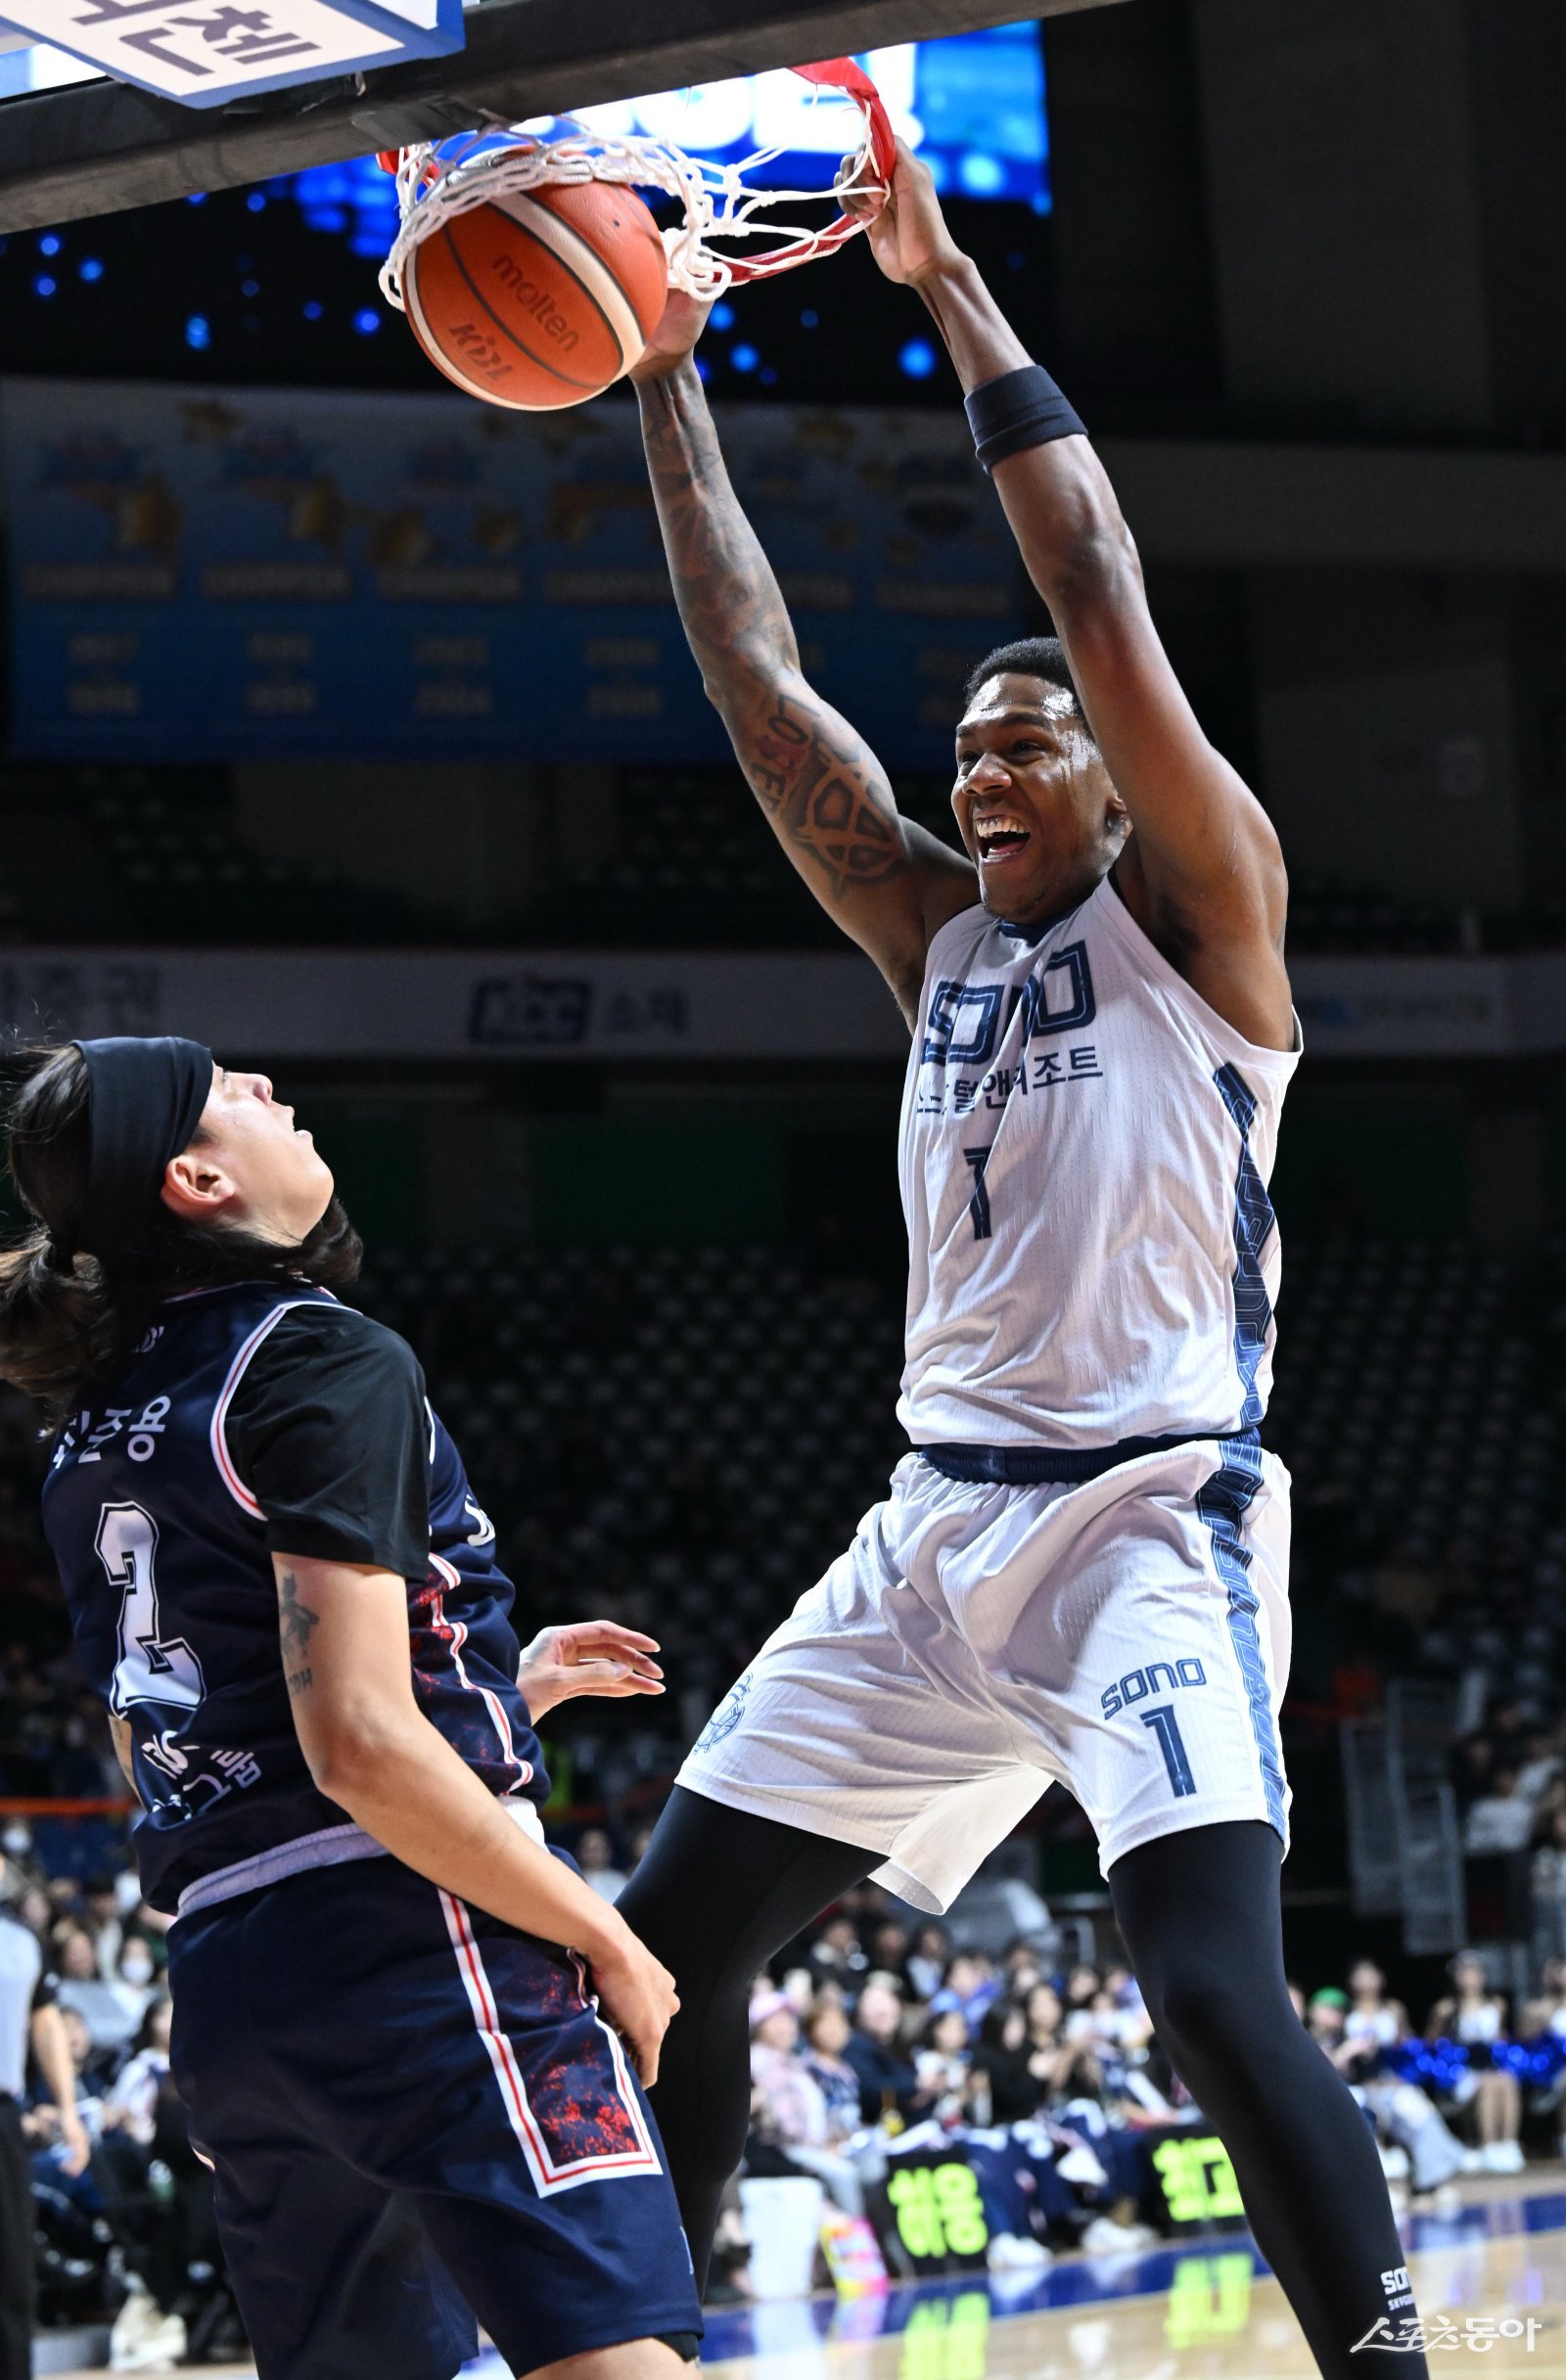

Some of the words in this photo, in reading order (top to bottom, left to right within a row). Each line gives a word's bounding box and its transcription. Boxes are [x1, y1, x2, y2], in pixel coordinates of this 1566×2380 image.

[492, 255, 580, 352] molten
[95, 1501, 206, 1719] 2
[1100, 1658, 1207, 1720] SONO
[1139, 1704, 1197, 1798] 1
